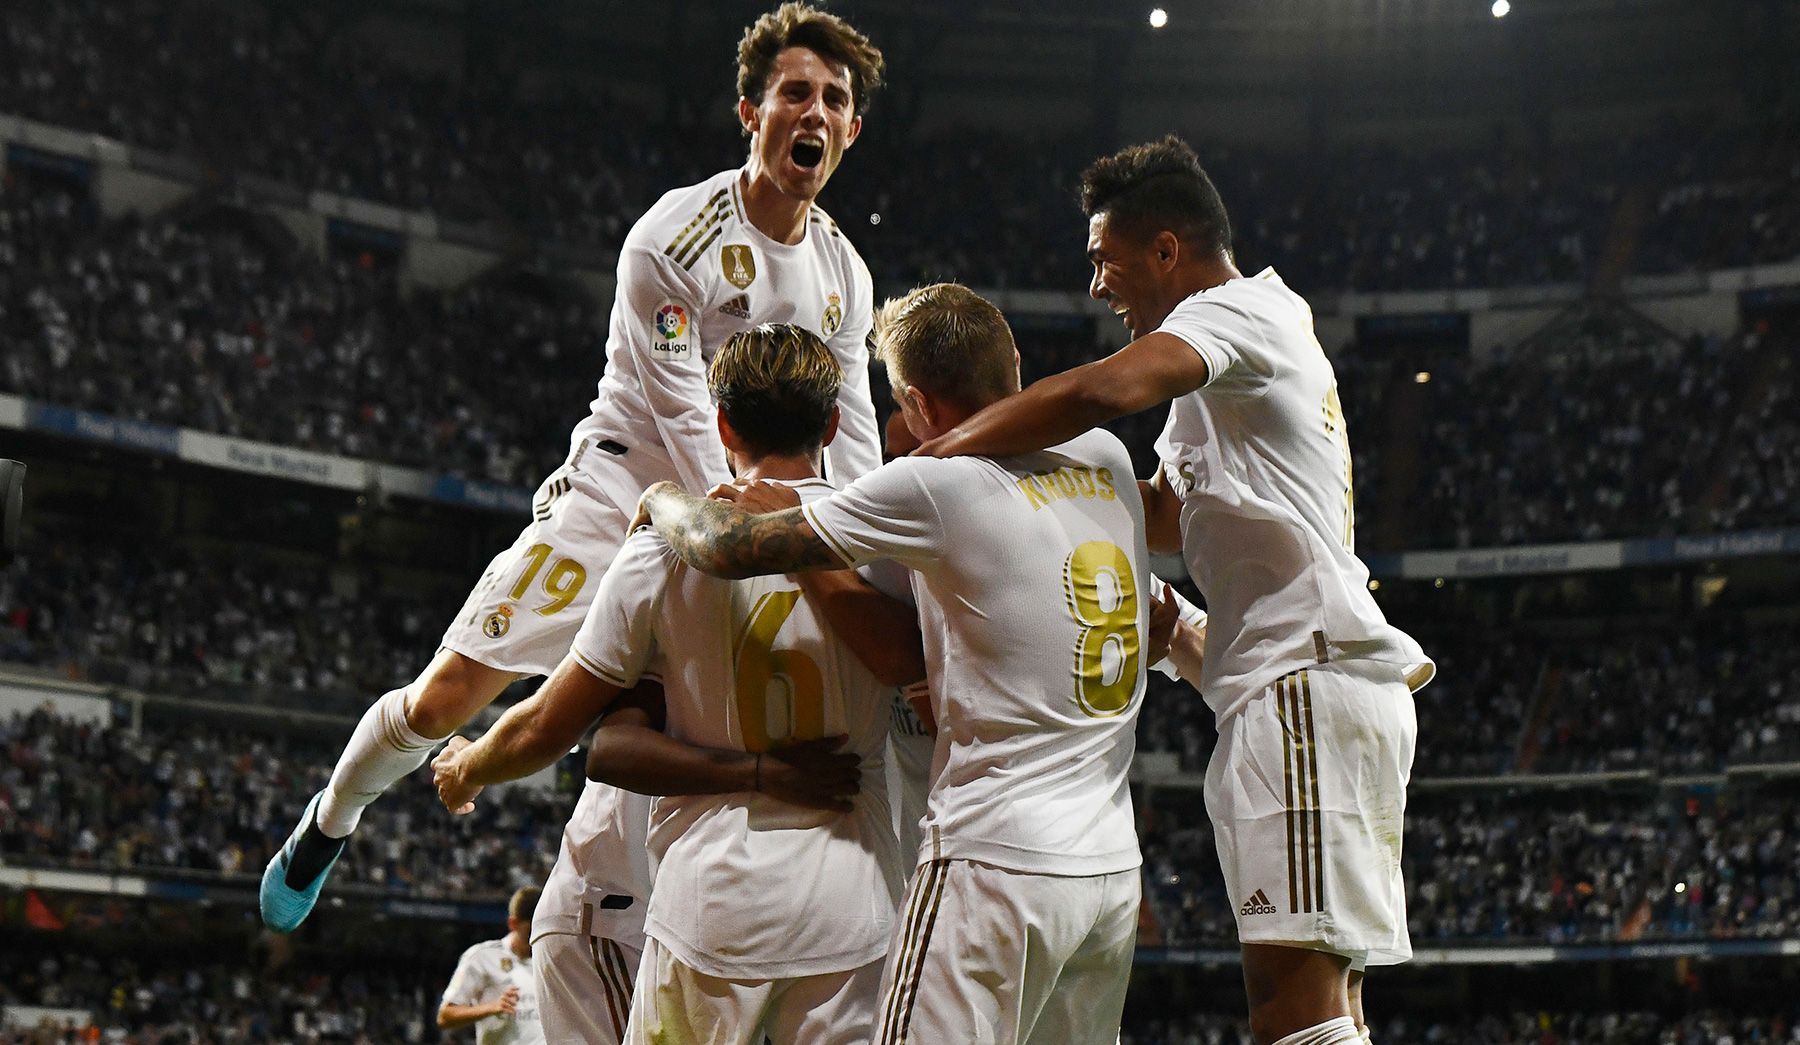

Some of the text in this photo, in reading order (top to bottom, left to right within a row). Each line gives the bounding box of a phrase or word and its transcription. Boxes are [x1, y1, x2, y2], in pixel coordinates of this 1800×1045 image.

[718, 305, 751, 320] adidas
[654, 341, 687, 353] LaLiga
[507, 543, 587, 616] 19
[1063, 541, 1140, 718] 8
[733, 590, 825, 752] 6
[1240, 905, 1277, 916] adidas
